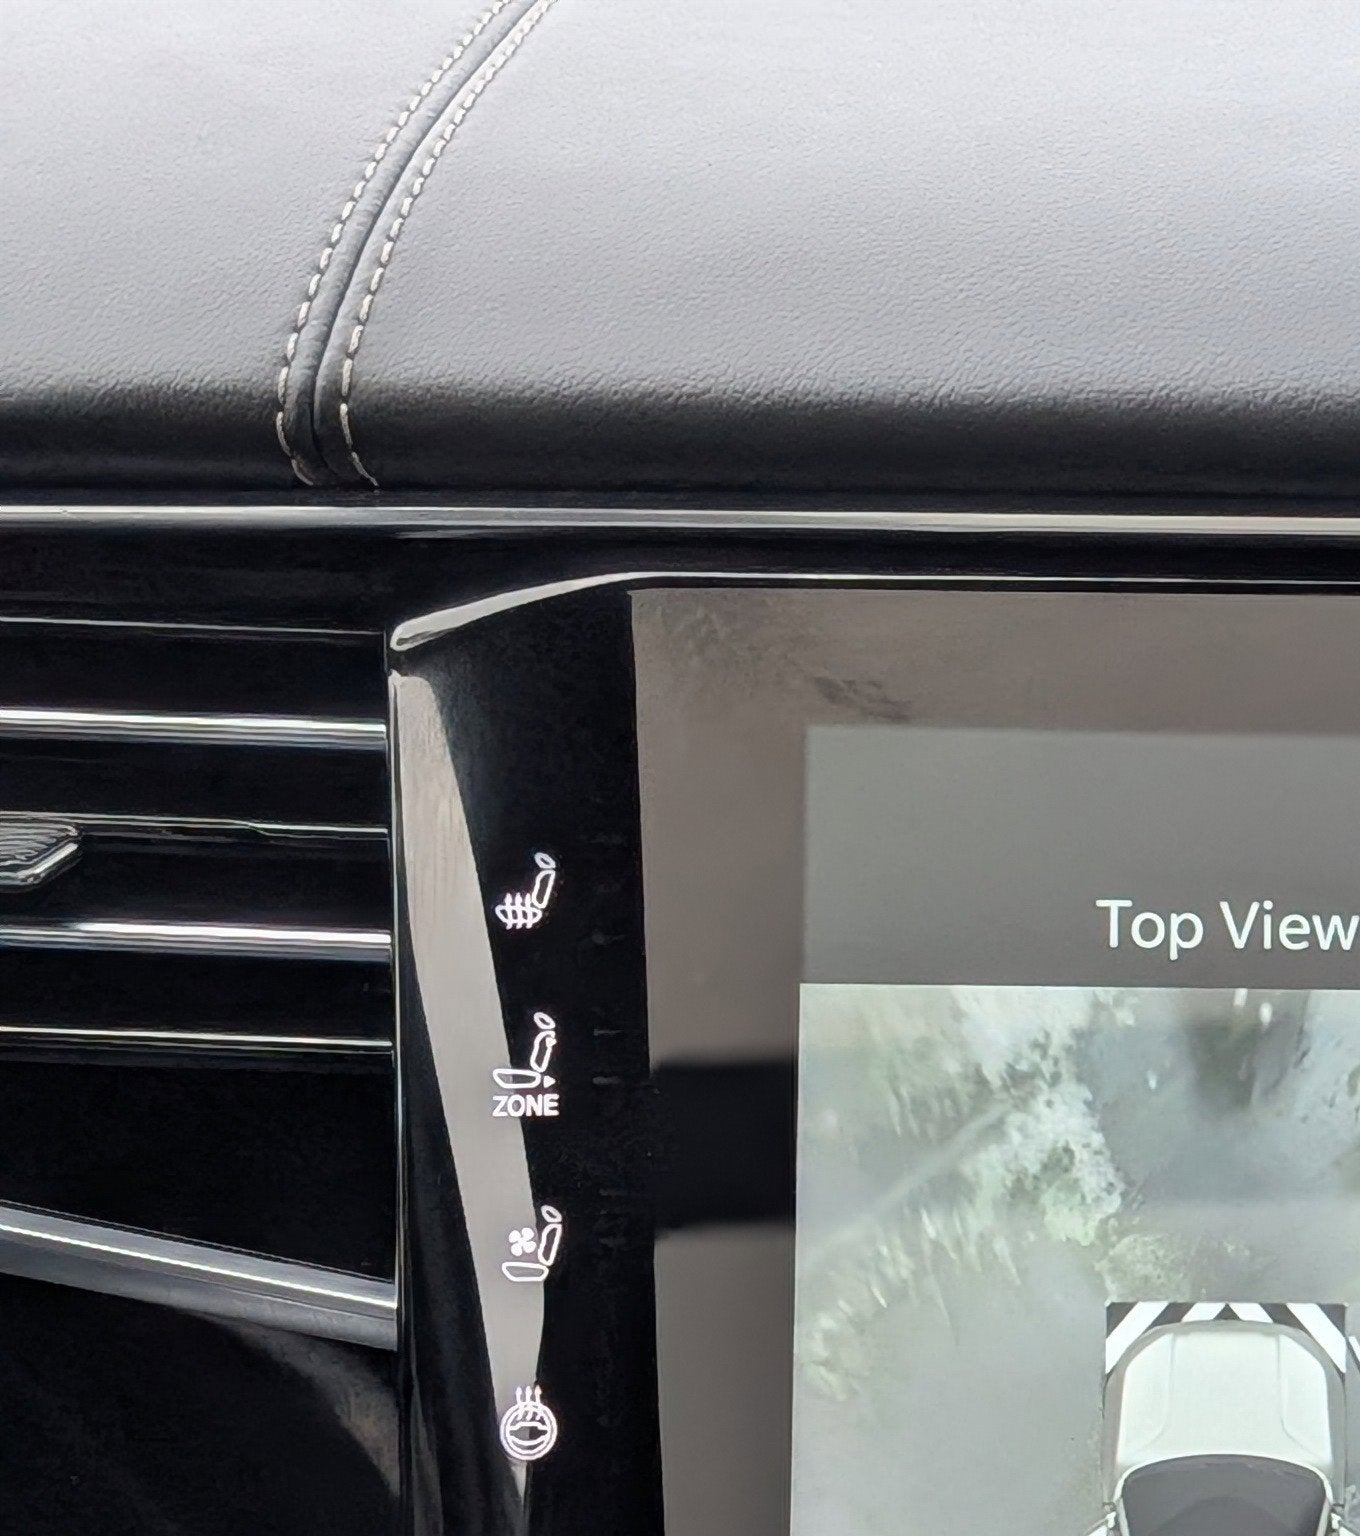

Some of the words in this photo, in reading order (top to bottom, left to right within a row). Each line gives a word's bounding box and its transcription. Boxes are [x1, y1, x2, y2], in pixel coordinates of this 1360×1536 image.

[1095, 899, 1204, 961] Top
[1219, 900, 1360, 951] View
[492, 1094, 559, 1117] ZONE
